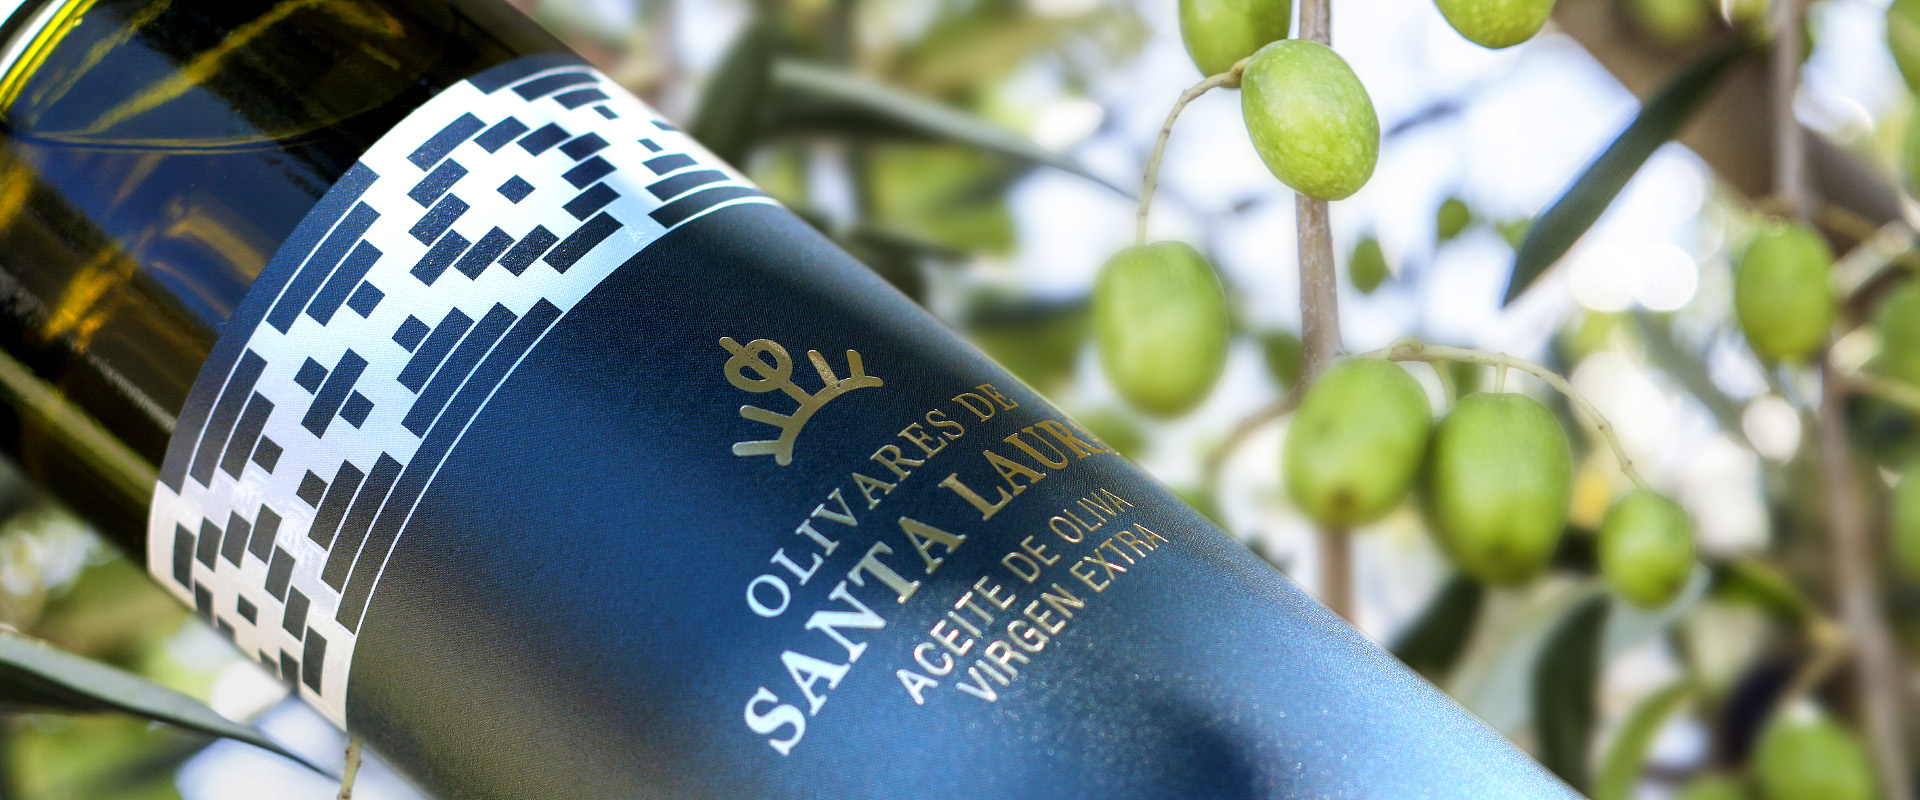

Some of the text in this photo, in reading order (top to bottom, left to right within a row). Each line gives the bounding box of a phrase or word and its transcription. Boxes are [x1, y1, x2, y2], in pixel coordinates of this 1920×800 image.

[746, 383, 1019, 618] OLIVARES DE
[896, 487, 1134, 705] ACEITE DE OLIVA
[956, 522, 1168, 702] VIRGEN EXTRA
[743, 516, 967, 757] SANTA
